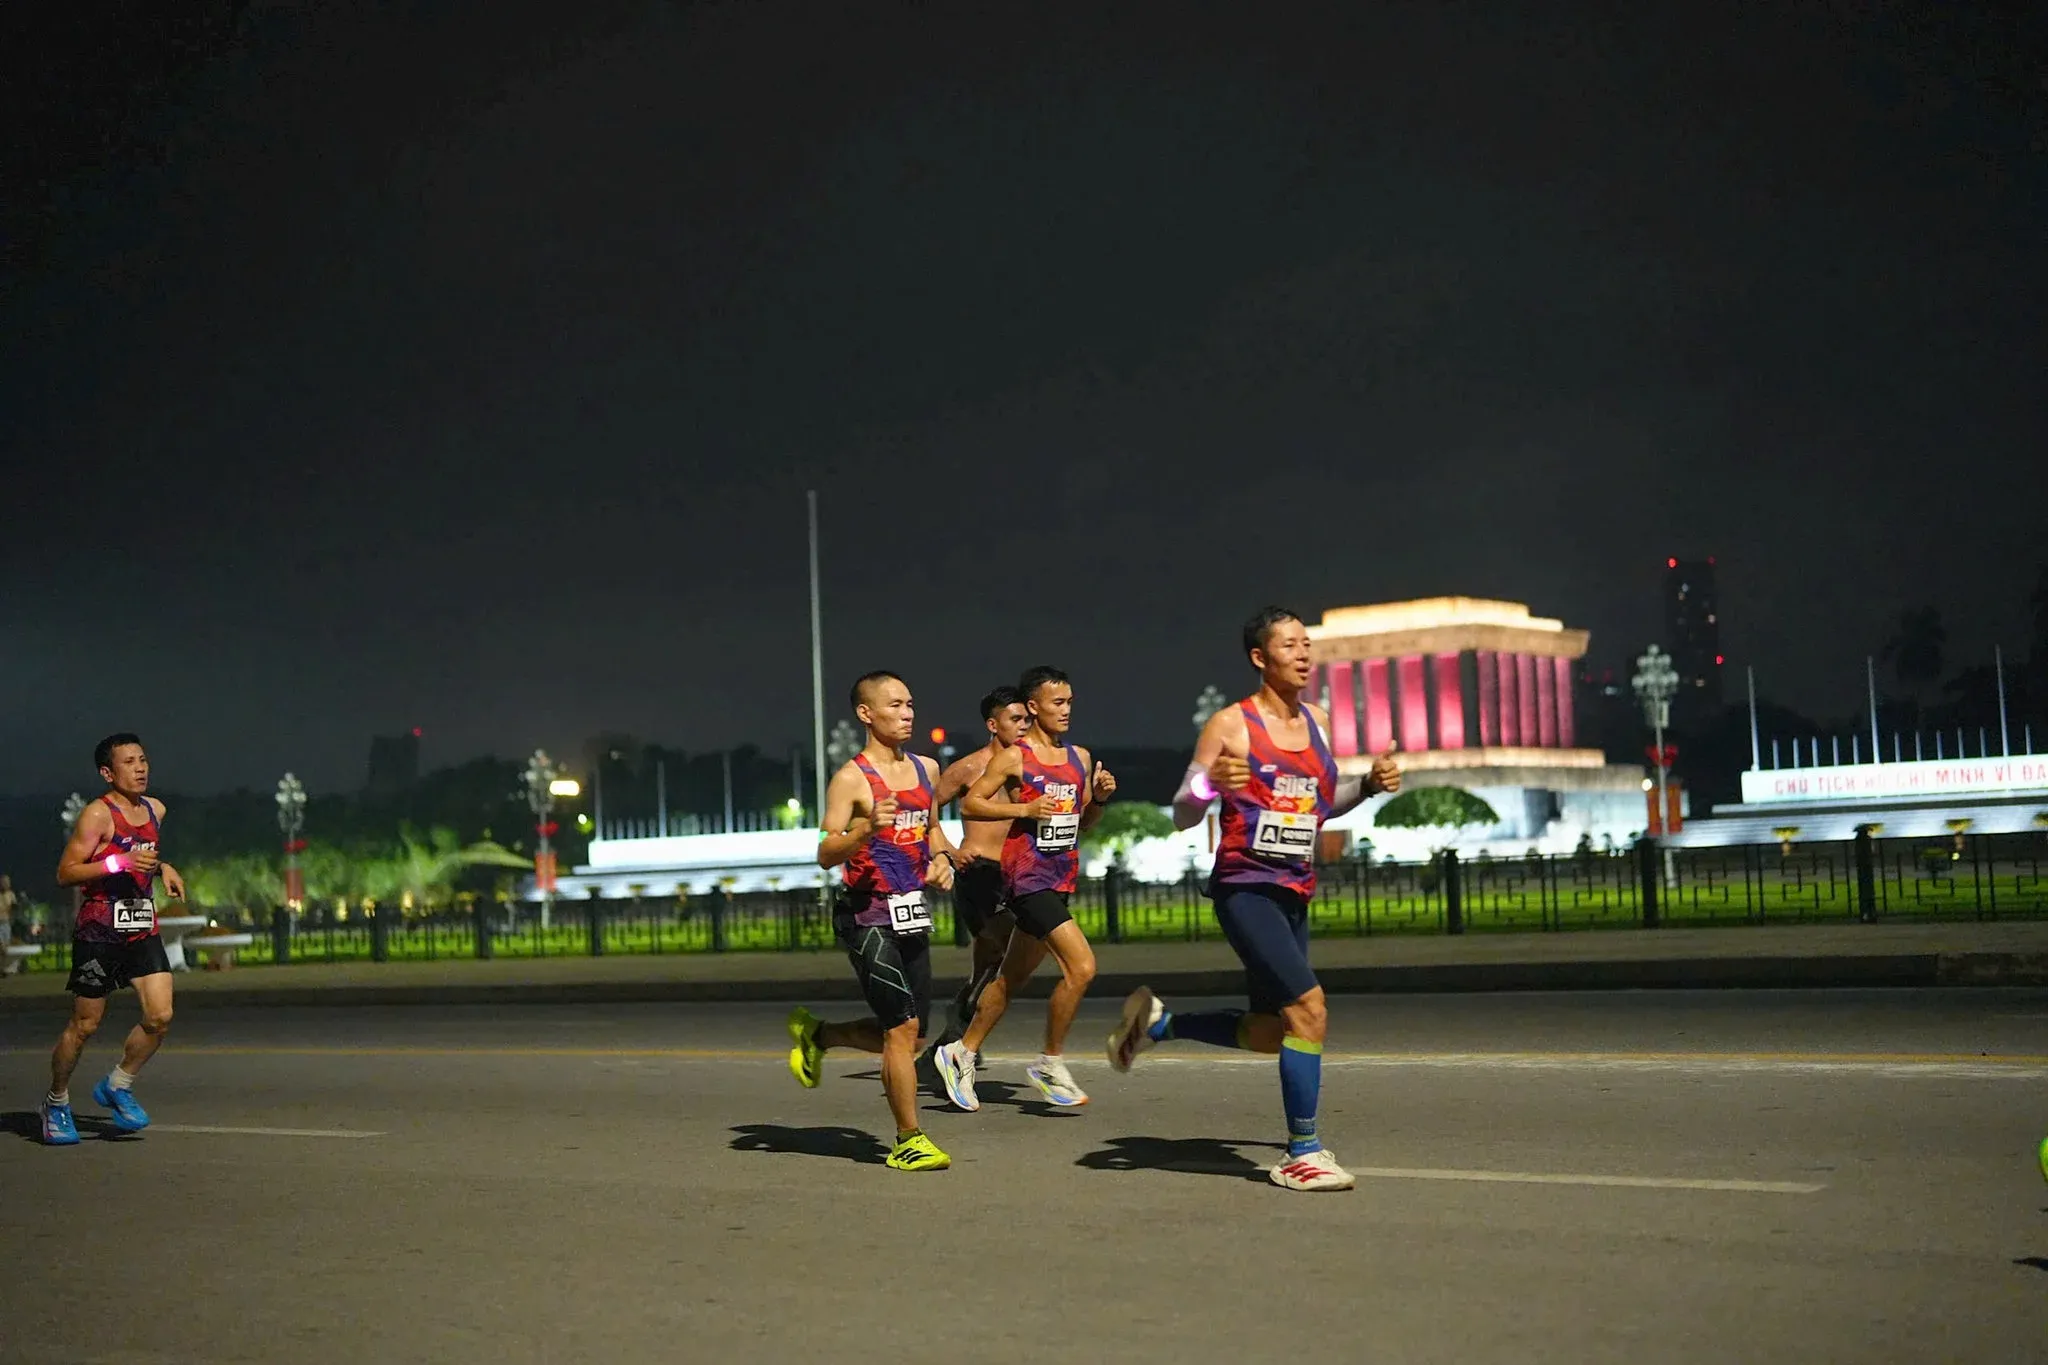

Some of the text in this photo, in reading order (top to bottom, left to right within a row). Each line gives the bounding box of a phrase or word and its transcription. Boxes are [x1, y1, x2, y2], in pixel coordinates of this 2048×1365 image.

[1936, 768, 1985, 787] MINH
[1272, 775, 1319, 799] SUB3
[895, 808, 929, 831] SUB3
[1261, 826, 1277, 842] A
[119, 910, 132, 921] A
[896, 907, 910, 921] B
